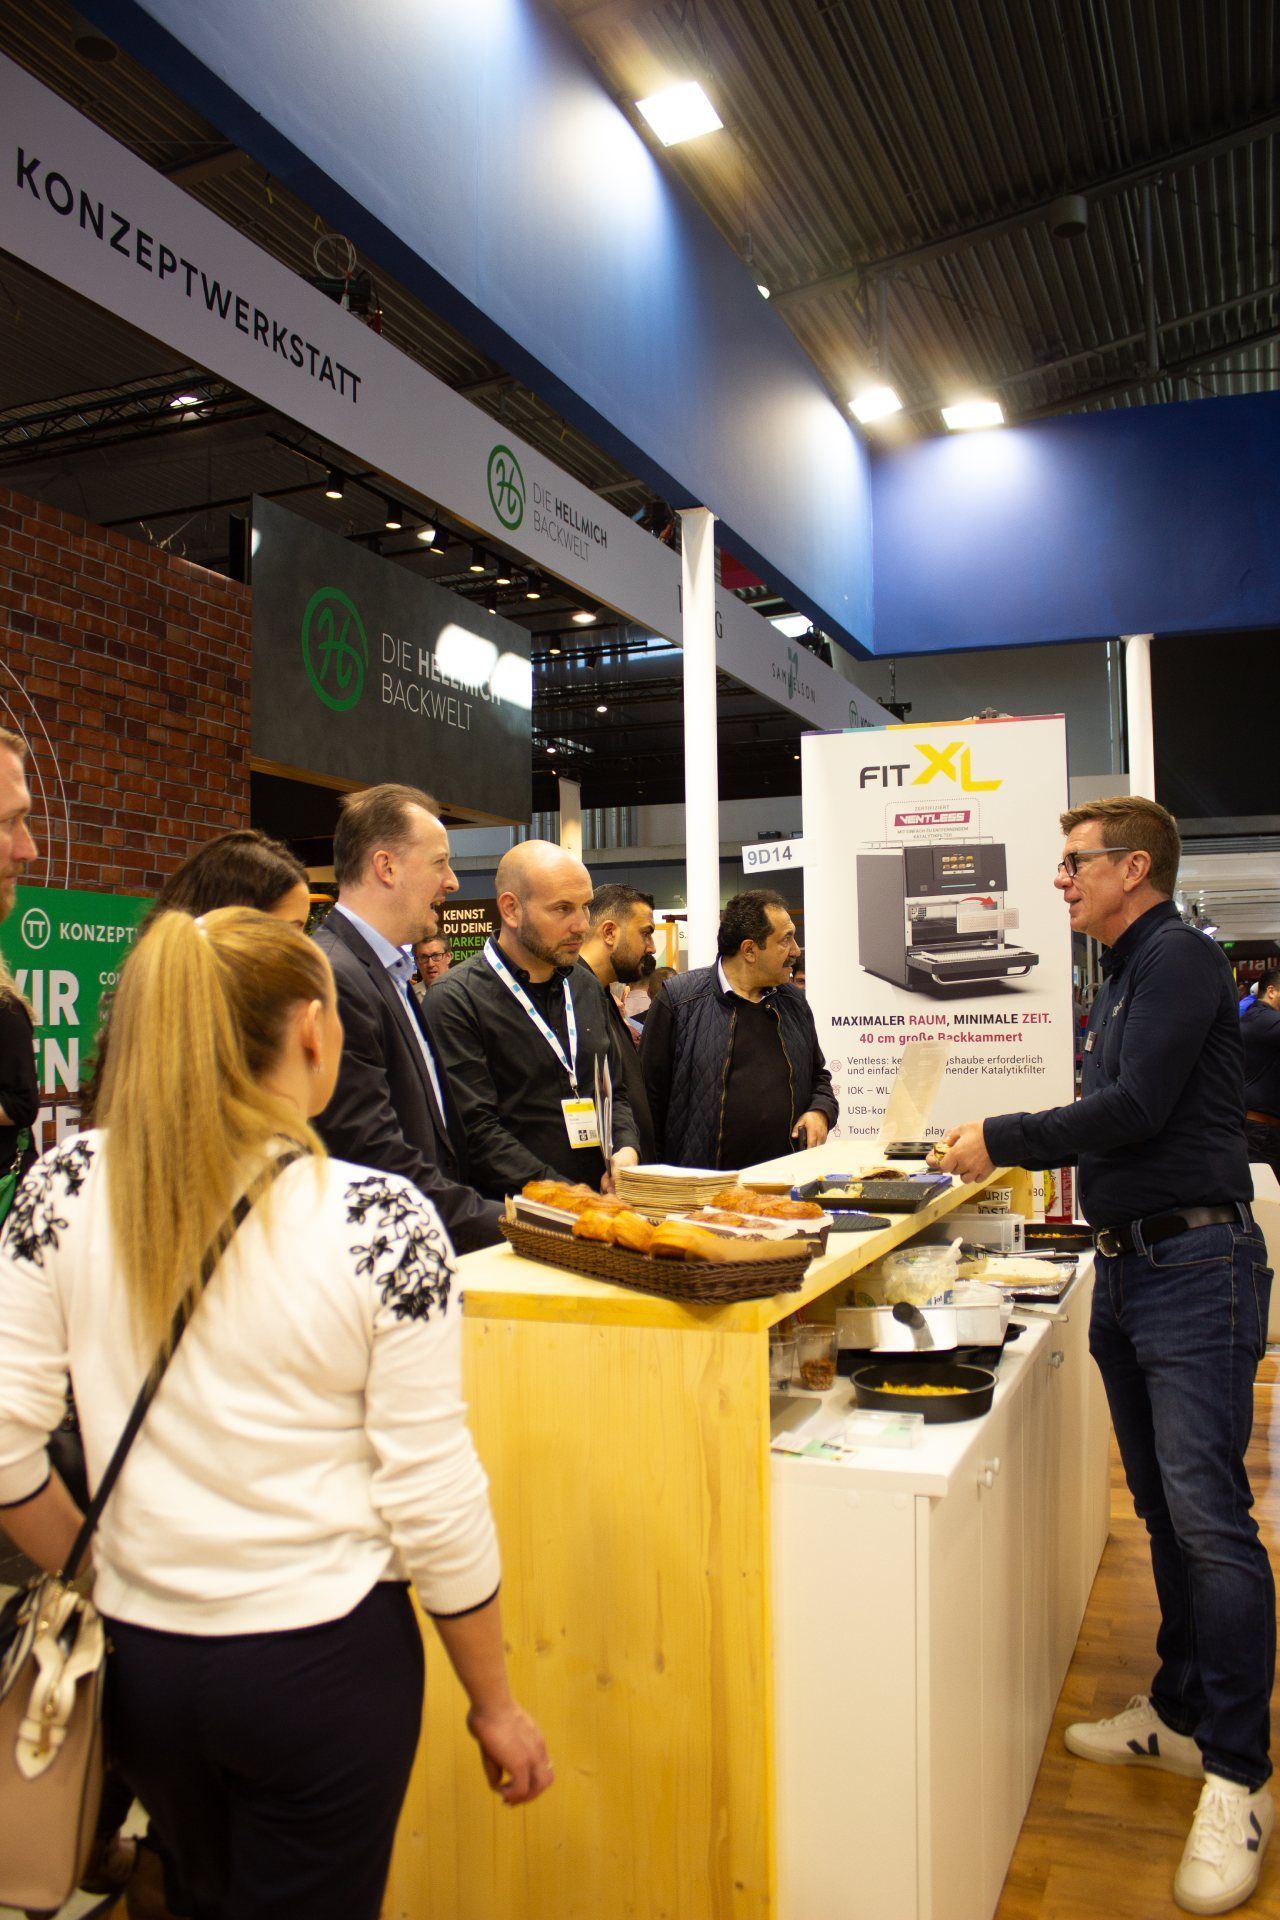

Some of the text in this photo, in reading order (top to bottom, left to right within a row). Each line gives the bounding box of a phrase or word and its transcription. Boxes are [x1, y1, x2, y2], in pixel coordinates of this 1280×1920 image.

[17, 147, 361, 403] KONZEPTWERKSTATT
[533, 482, 607, 548] DIE HELLMICH
[533, 510, 590, 561] BACKWELT
[382, 632, 412, 671] DIE
[382, 672, 472, 730] BACKWELT
[859, 741, 1003, 791] FIT XL
[900, 812, 965, 824] VENTLESS
[747, 845, 792, 866] 9D14
[443, 908, 485, 921] KENNST
[60, 922, 138, 943] KONZEPT
[443, 922, 493, 934] DU DEINE
[450, 935, 488, 948] ARKEN
[832, 1013, 1051, 1027] MAXIMALER RAUM, MINIMALE ZEIT.
[859, 1033, 874, 1044] 40
[878, 1035, 895, 1044] cm
[847, 1056, 889, 1065] Ventless:
[987, 1055, 1043, 1064] erforderlich
[847, 1066, 864, 1075] und
[981, 1065, 1046, 1077] Katalytikfilter
[876, 1086, 891, 1095] WL
[925, 1126, 945, 1138] play
